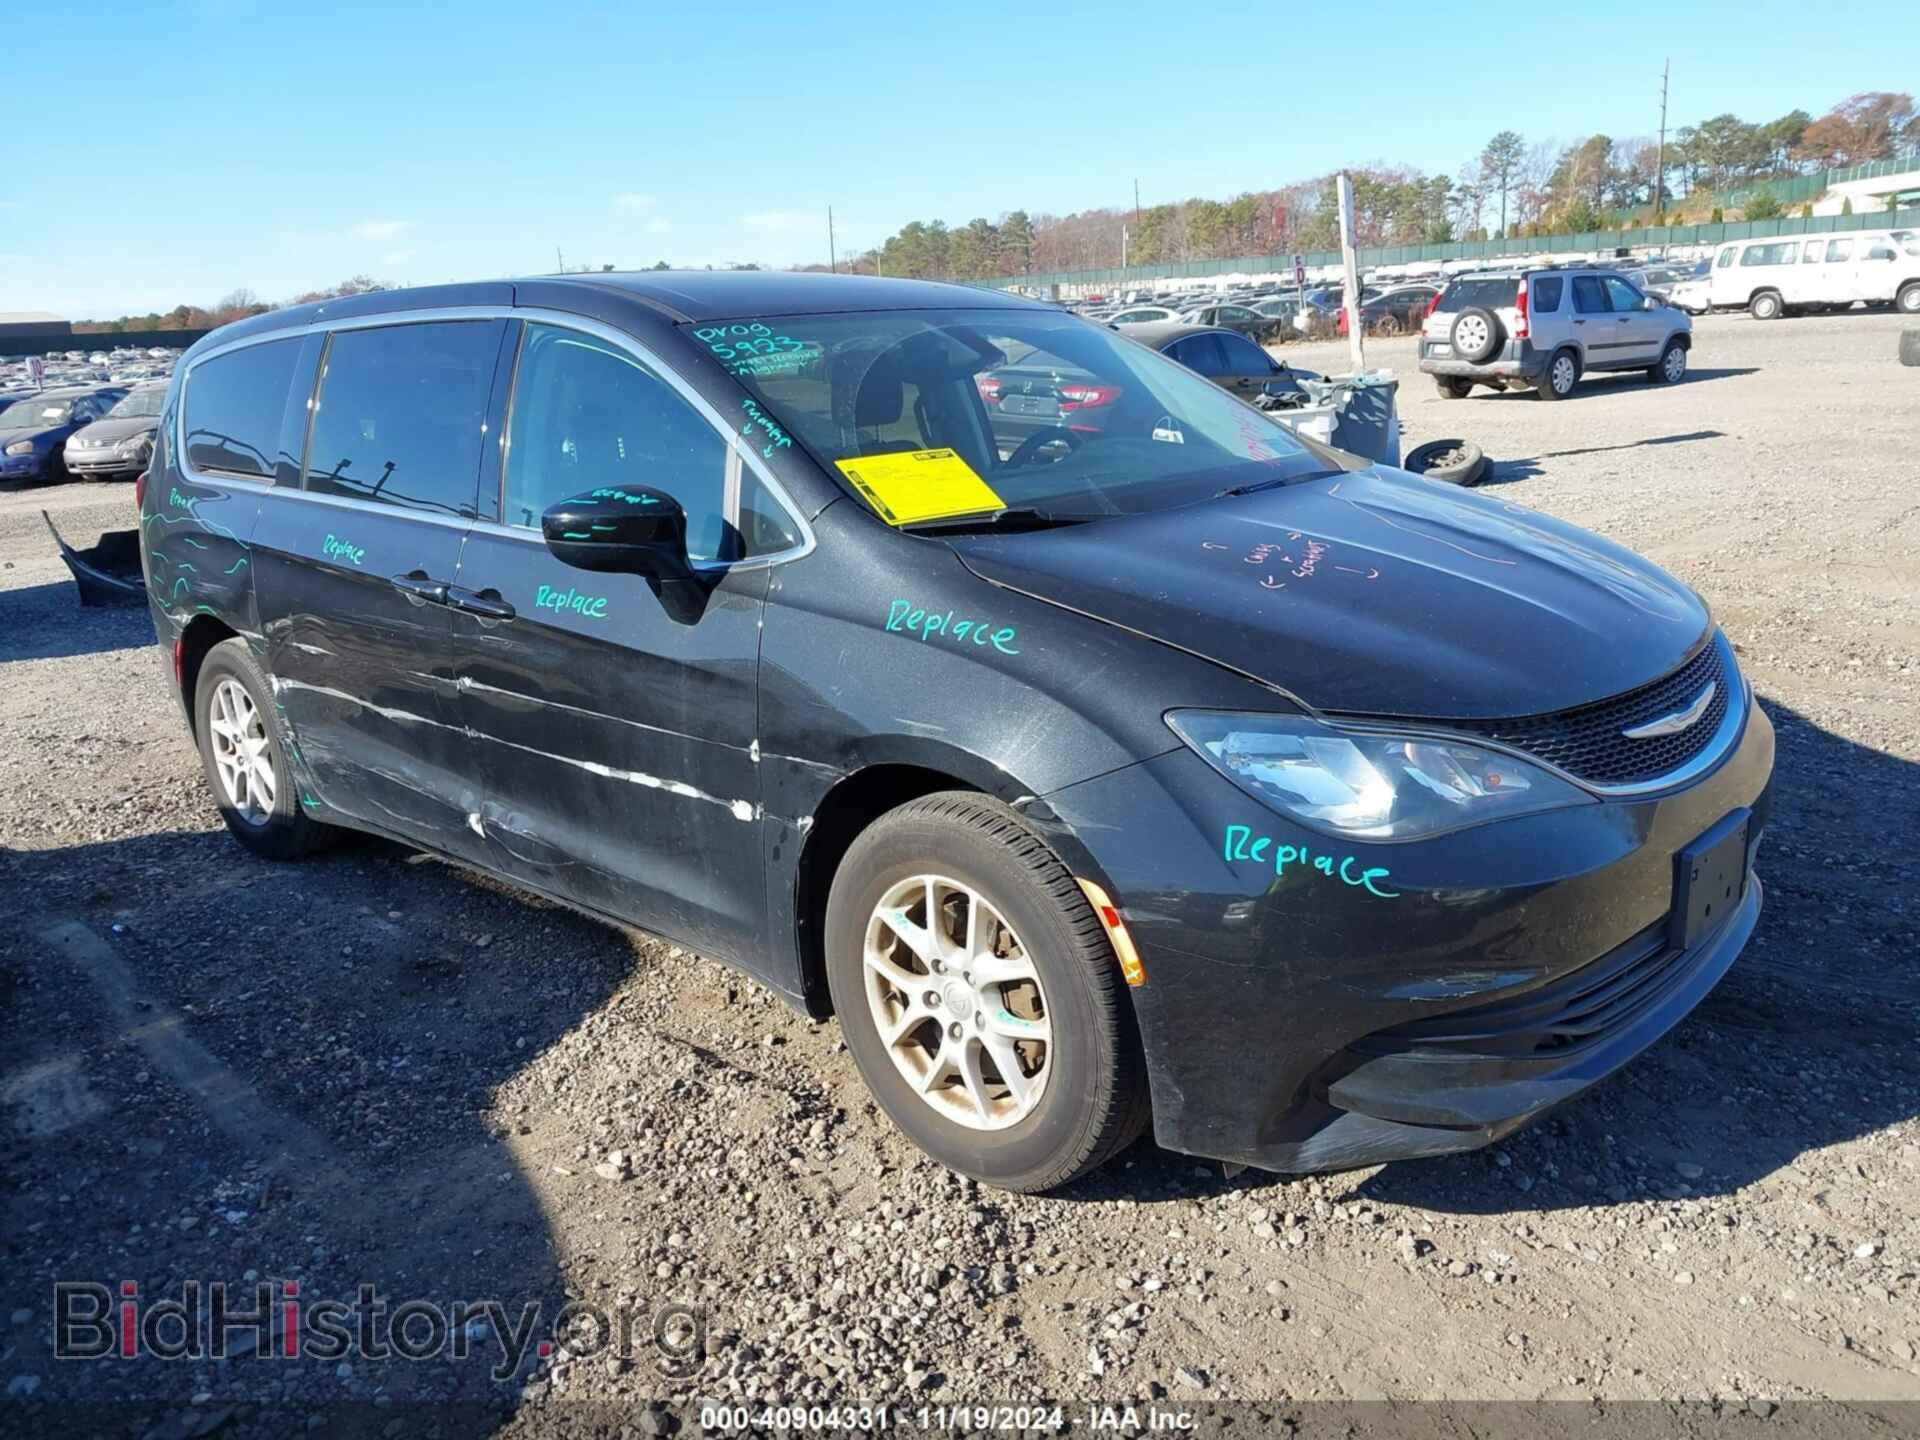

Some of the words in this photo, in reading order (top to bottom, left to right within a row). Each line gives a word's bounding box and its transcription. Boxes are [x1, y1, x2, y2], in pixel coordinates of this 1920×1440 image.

[322, 533, 366, 565] Replace
[535, 584, 608, 619] Replace
[886, 598, 1020, 656] Replace
[1224, 824, 1400, 898] Replace
